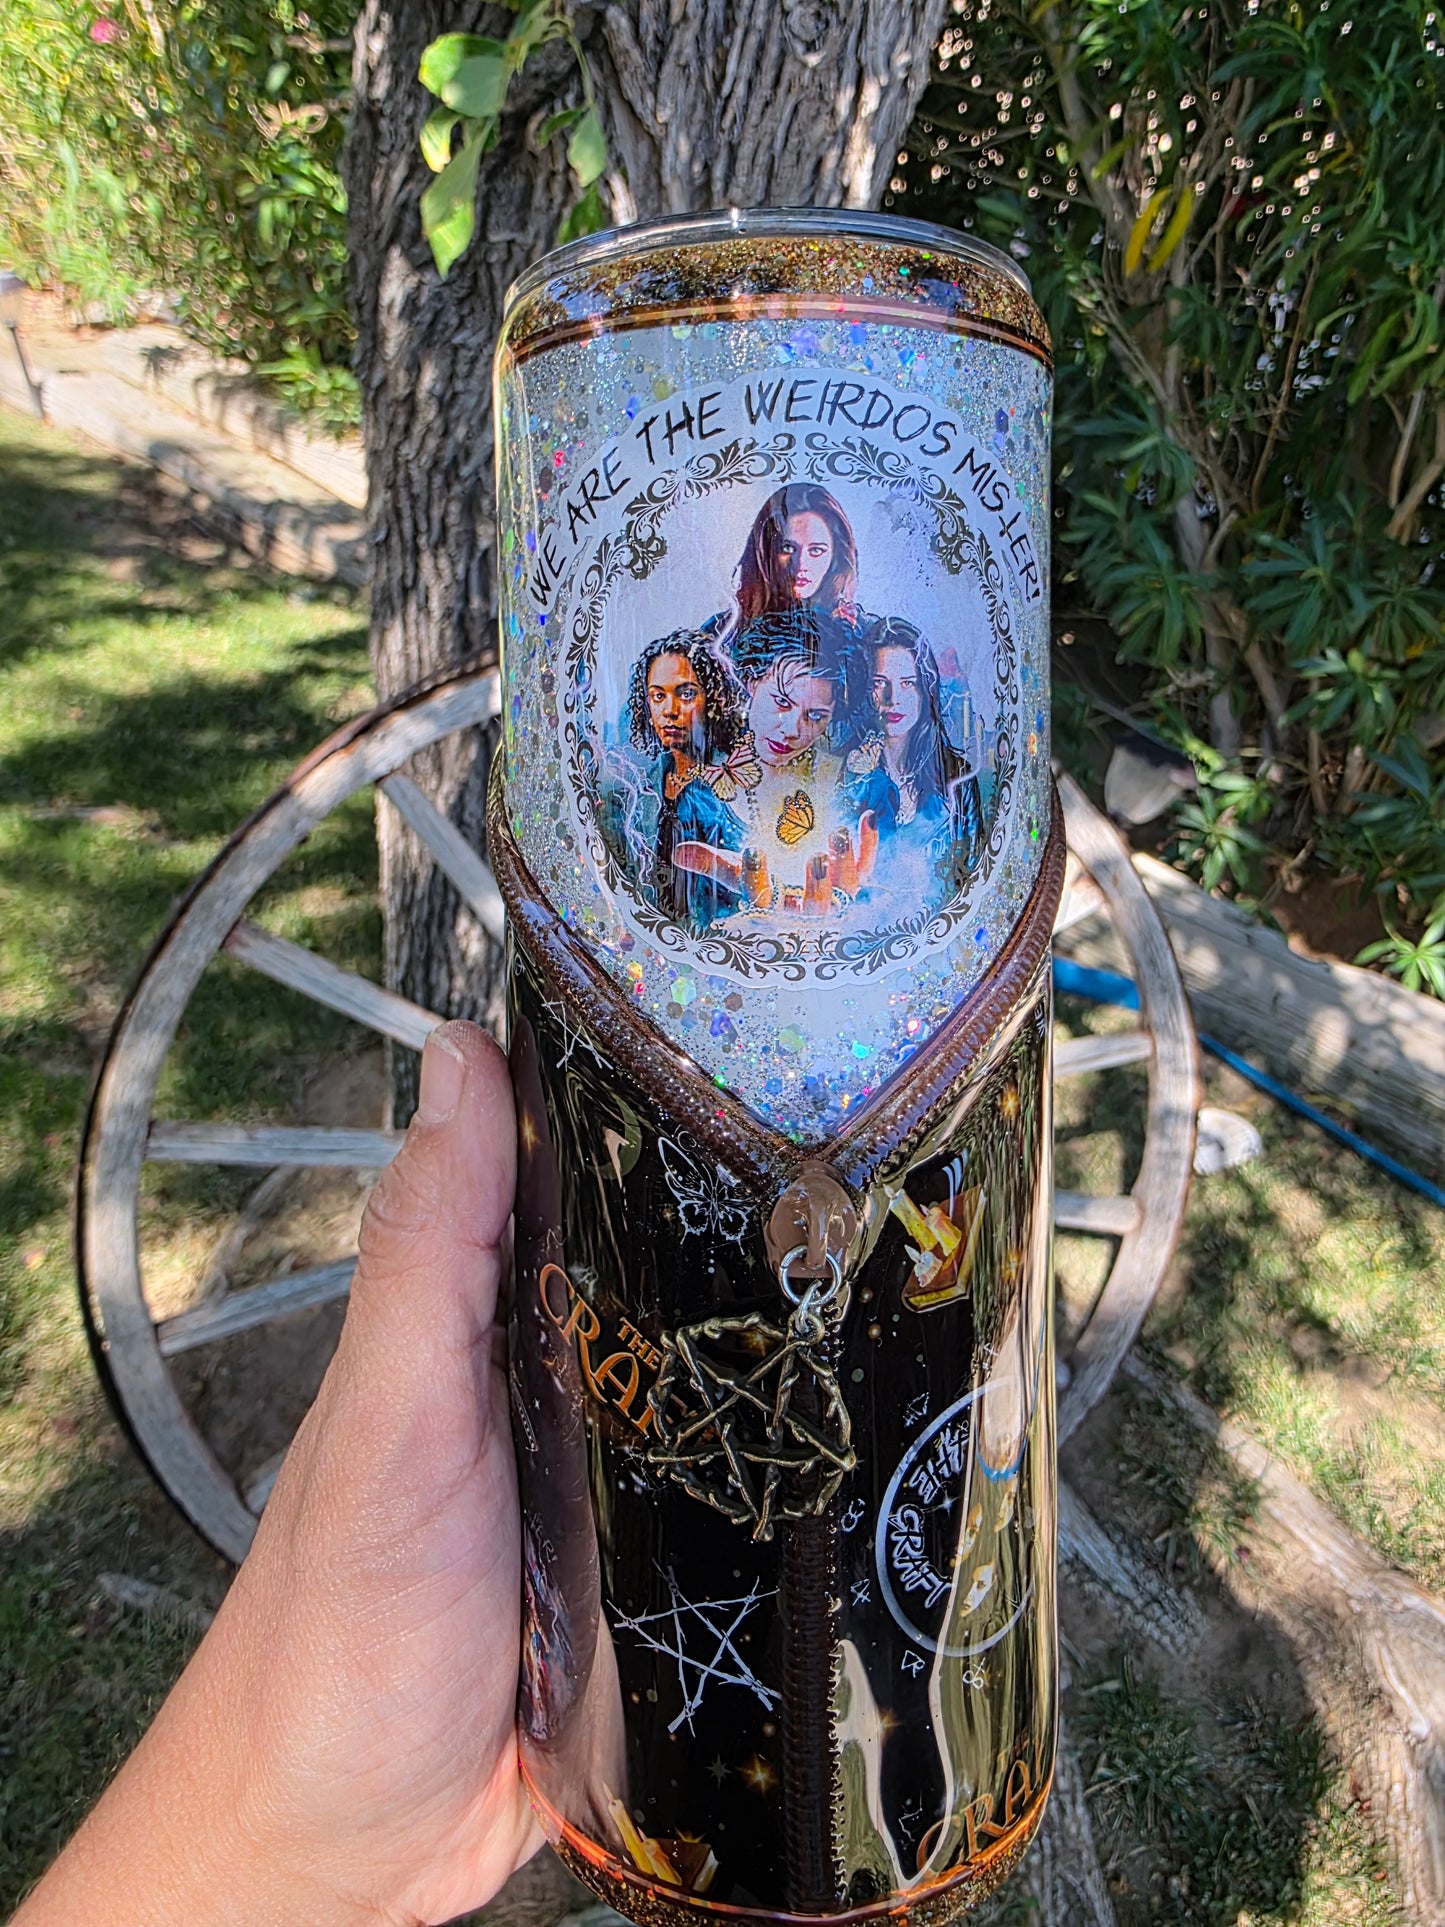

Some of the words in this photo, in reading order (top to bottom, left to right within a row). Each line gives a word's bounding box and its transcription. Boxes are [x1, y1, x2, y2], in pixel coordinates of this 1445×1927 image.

[531, 534, 566, 606] WE
[566, 447, 631, 545] ARE
[635, 391, 726, 465] THE
[745, 377, 958, 457] WEIRDOS
[953, 447, 1039, 603] MISTER!
[617, 1317, 664, 1372] THE
[889, 1504, 954, 1609] CRAFT
